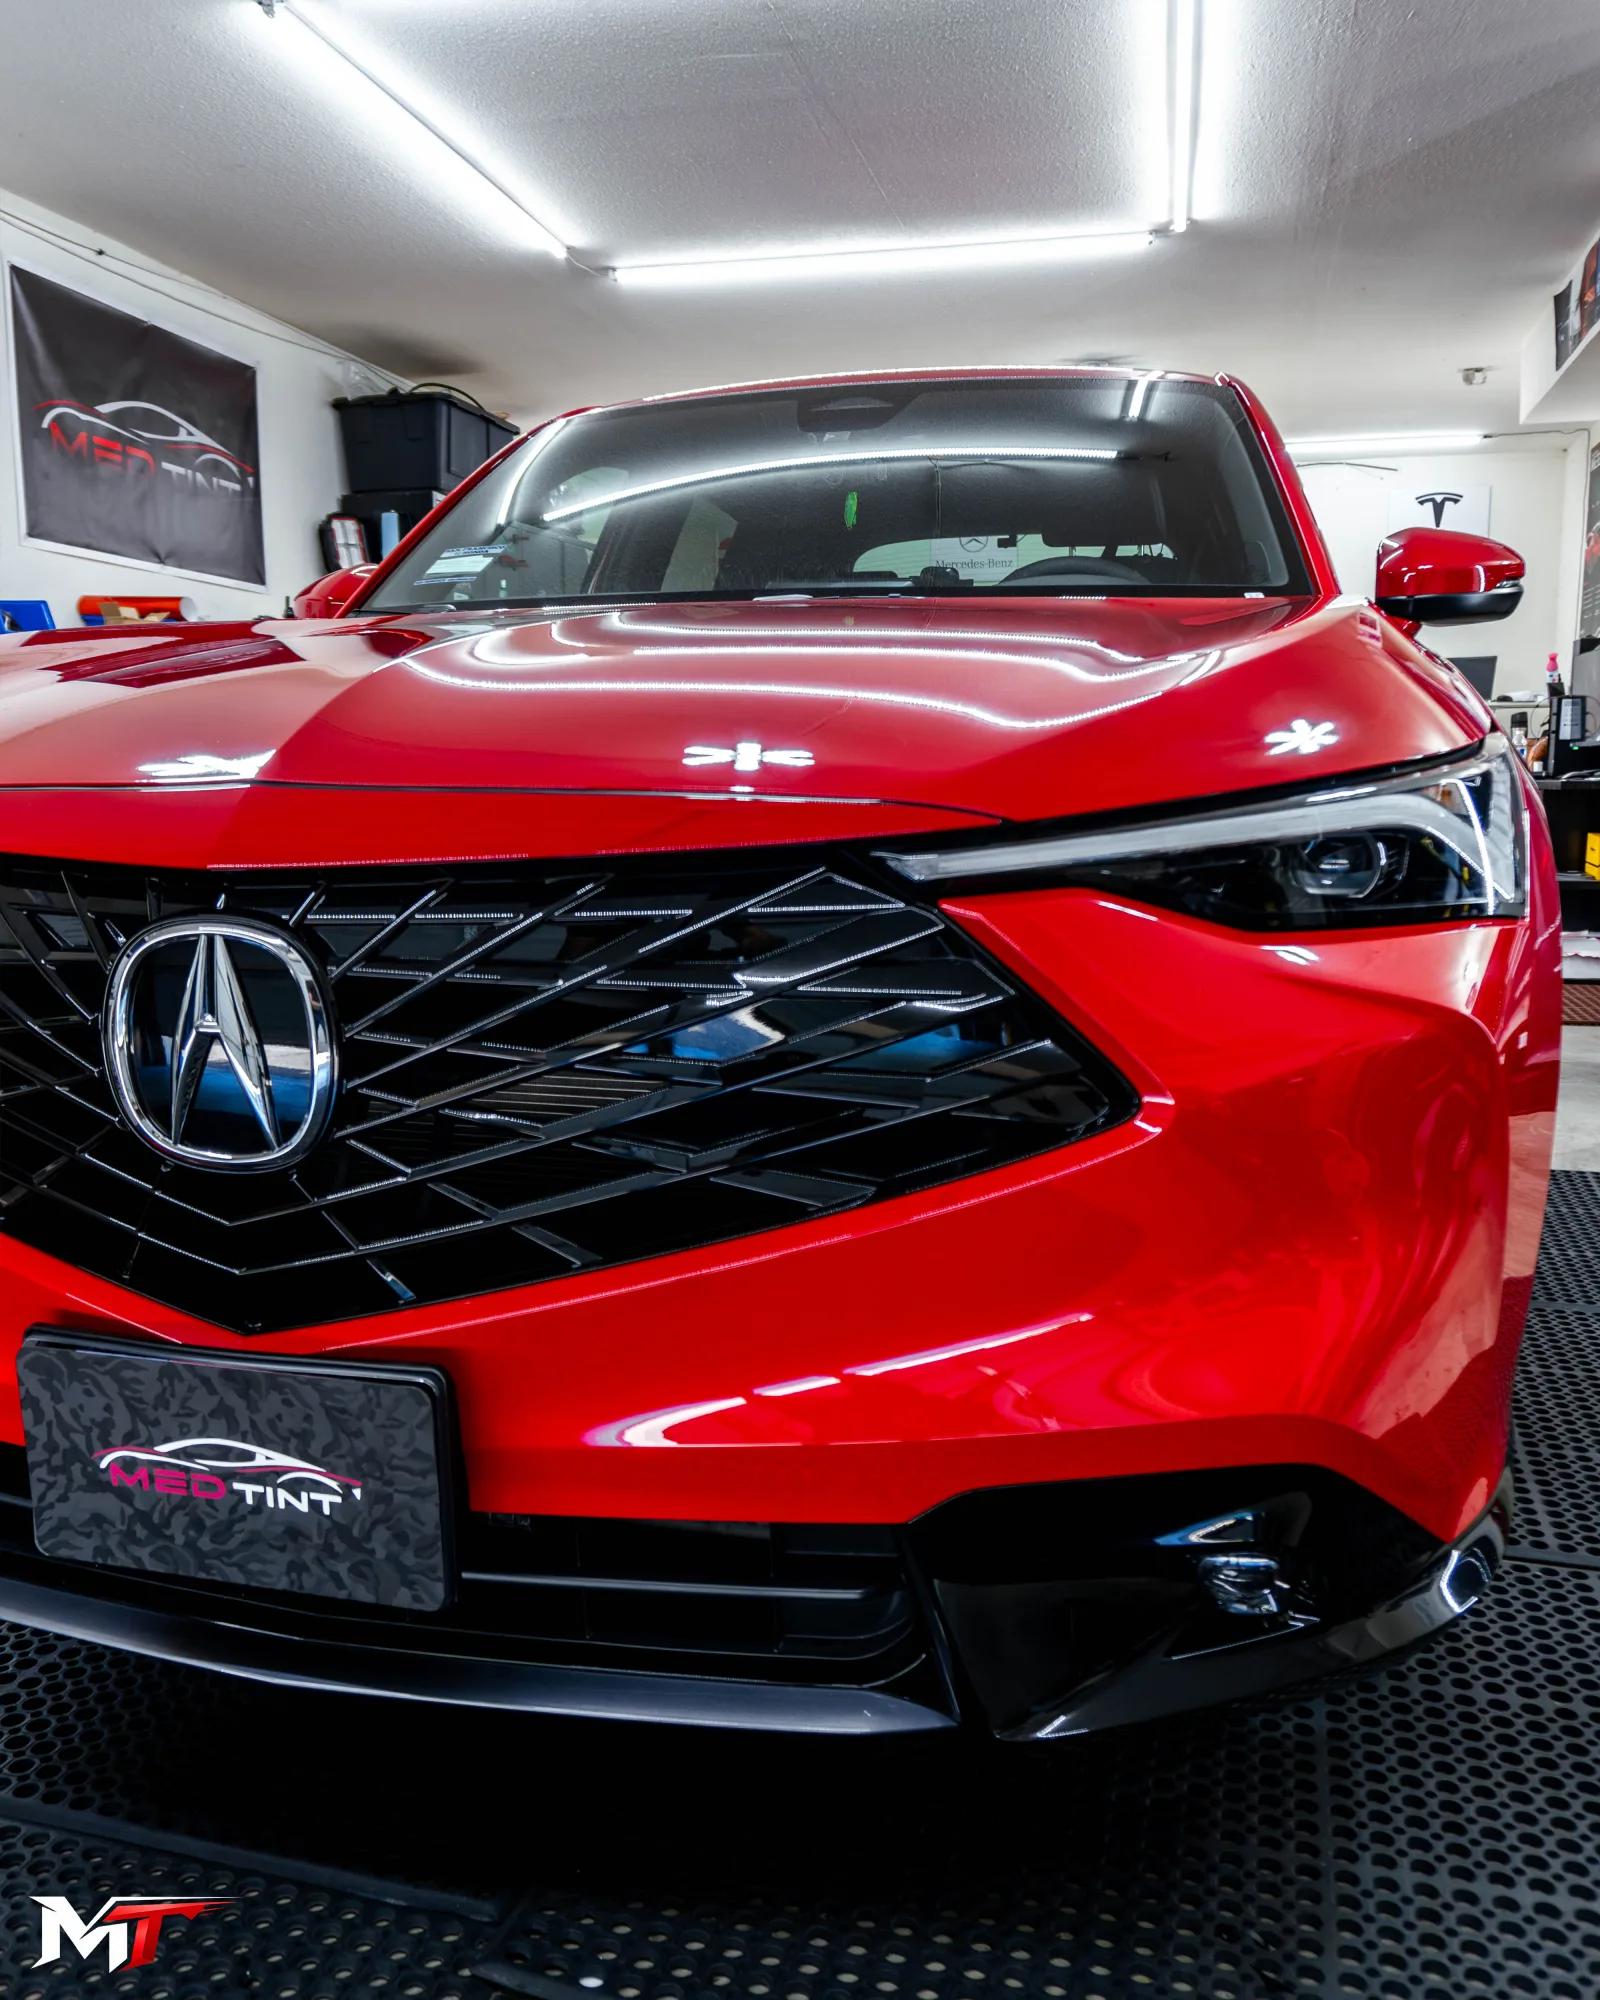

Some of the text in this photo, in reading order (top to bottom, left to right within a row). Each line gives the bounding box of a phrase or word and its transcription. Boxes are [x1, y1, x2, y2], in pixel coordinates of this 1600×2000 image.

[50, 421, 242, 496] MED TINT
[935, 558, 1013, 569] Mercedes-Benz
[109, 1463, 342, 1516] MED TINT
